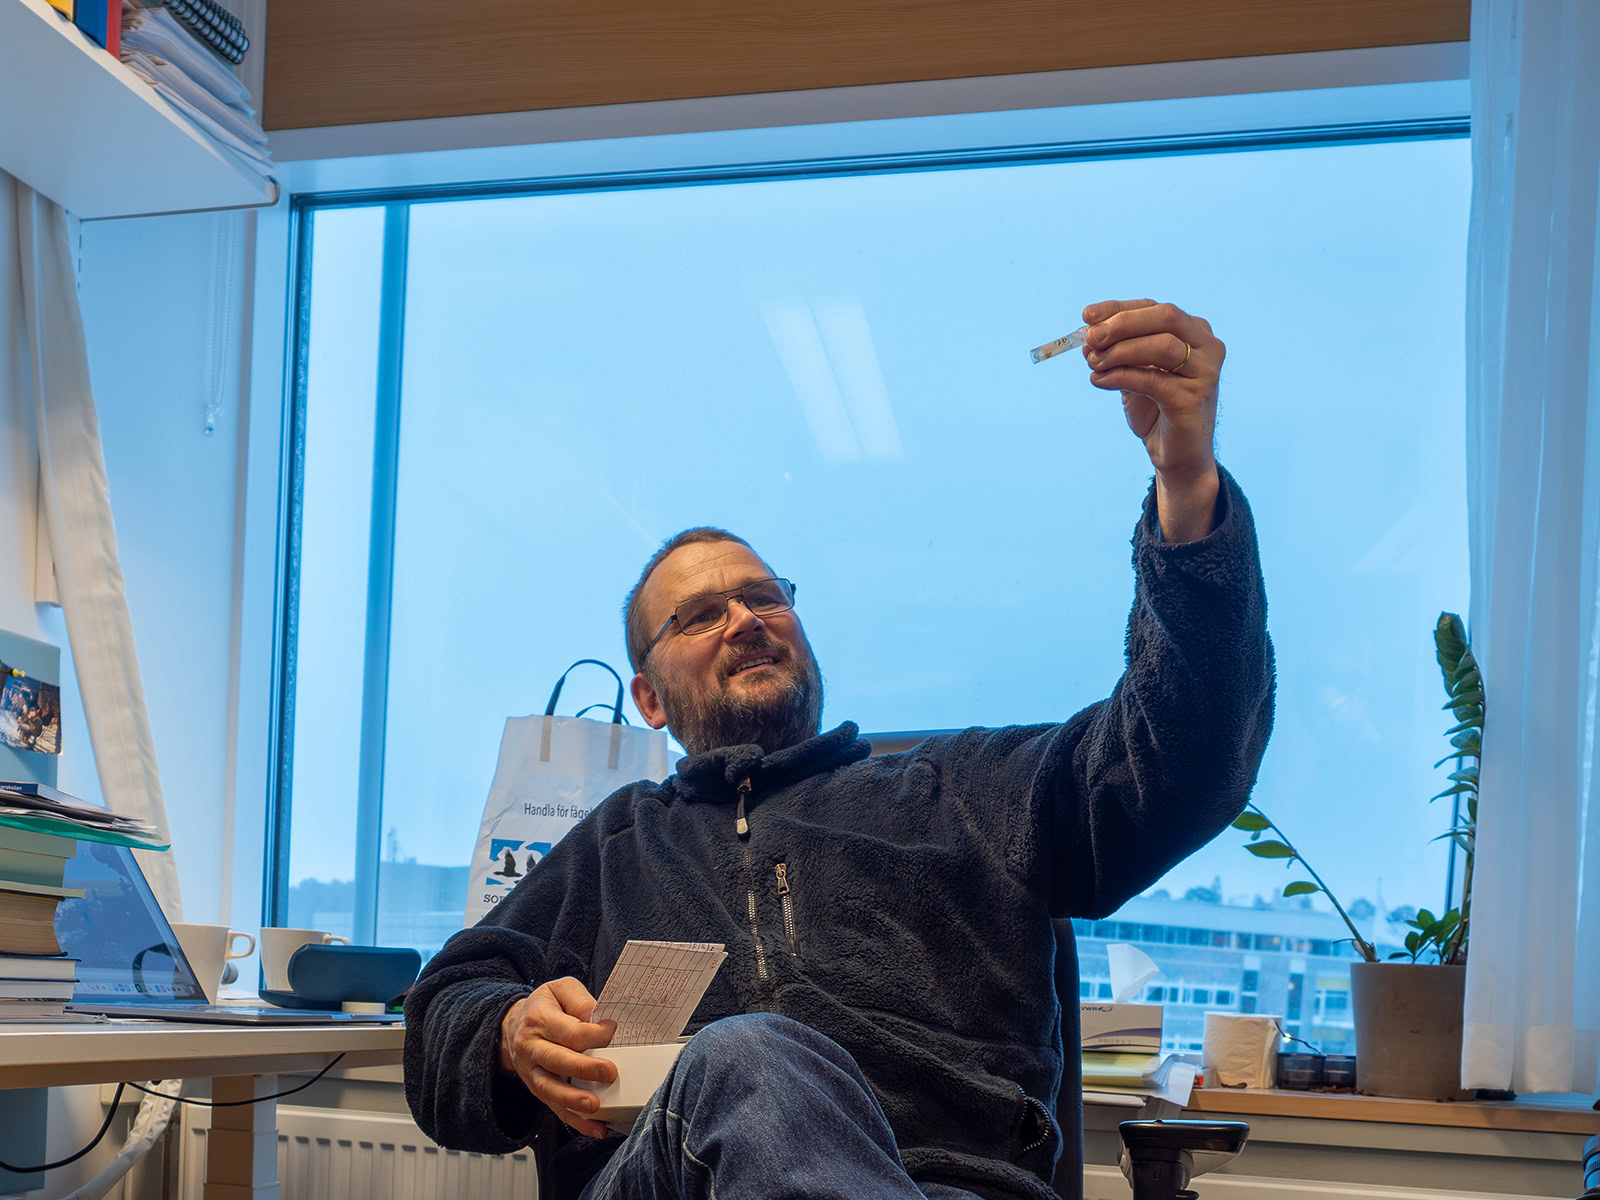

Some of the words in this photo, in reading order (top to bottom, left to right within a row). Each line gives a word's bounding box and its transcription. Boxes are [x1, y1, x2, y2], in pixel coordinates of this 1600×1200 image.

[524, 803, 555, 817] Handla
[557, 804, 568, 818] för
[570, 805, 592, 822] fåge
